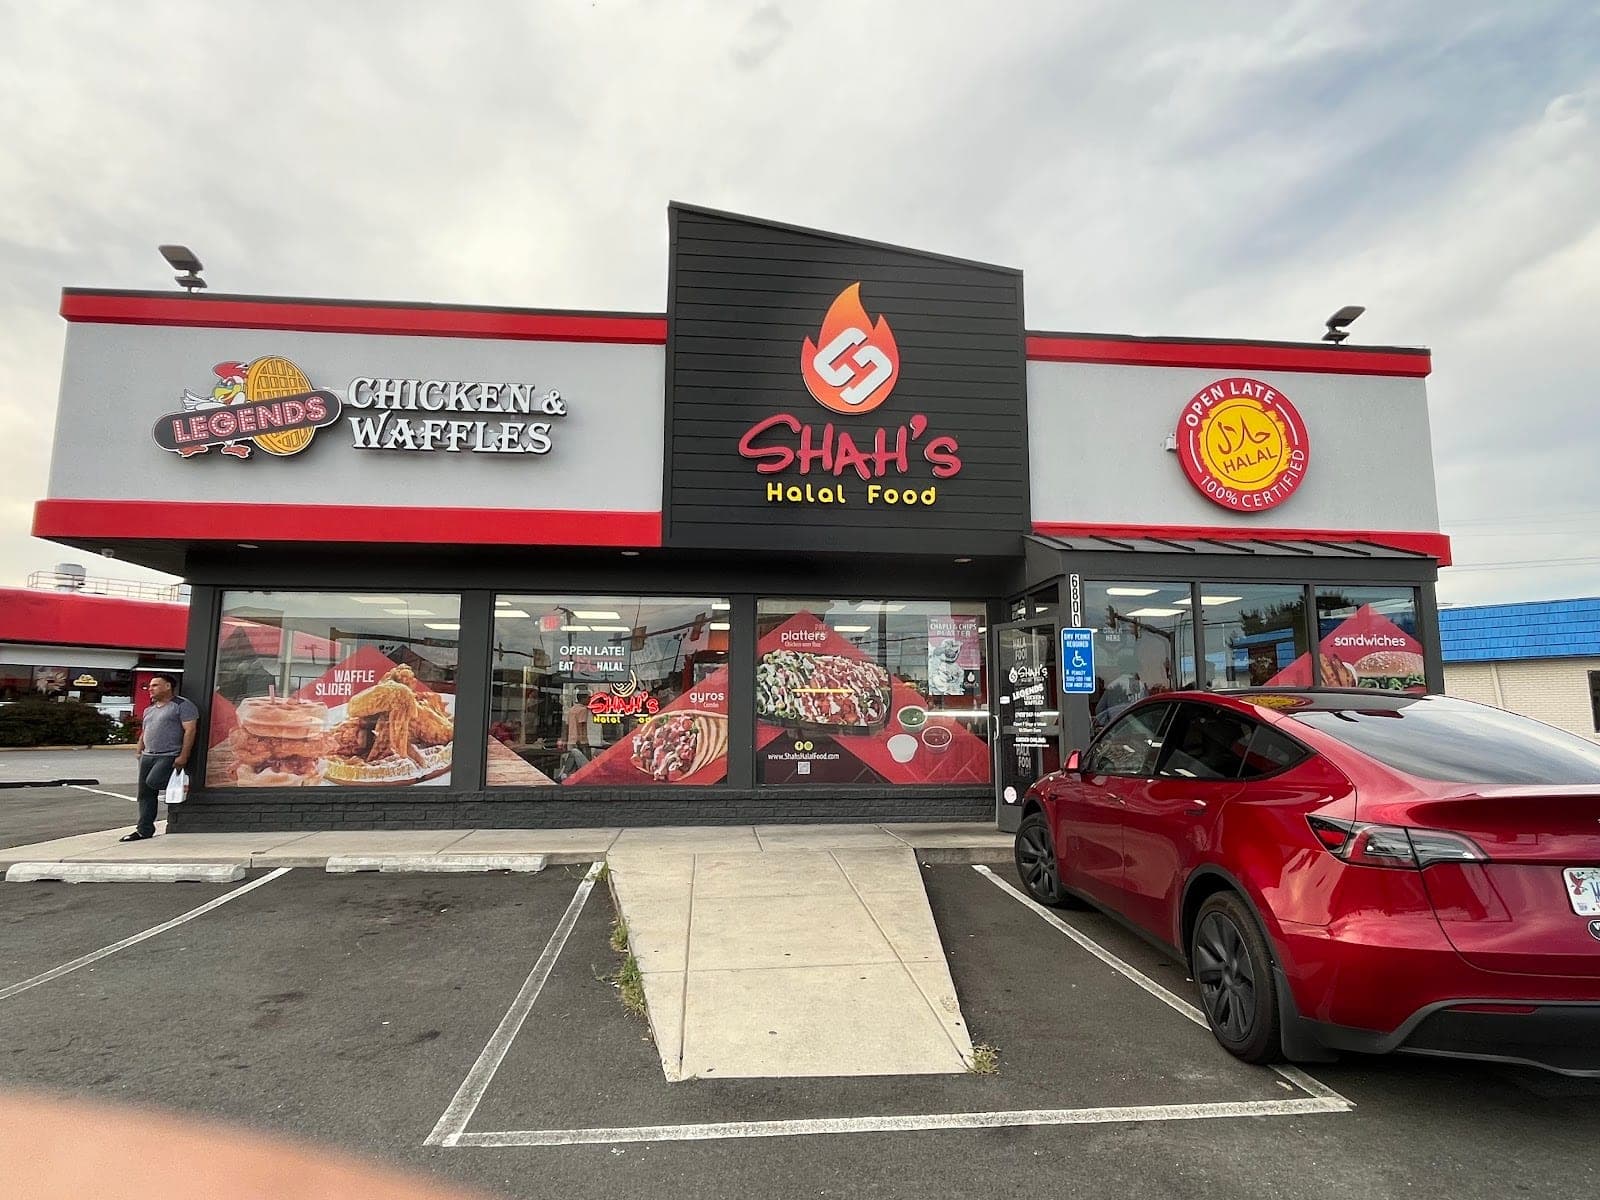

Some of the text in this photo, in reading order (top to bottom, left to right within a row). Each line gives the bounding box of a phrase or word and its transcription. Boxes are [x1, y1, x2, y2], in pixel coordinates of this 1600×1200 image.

[347, 377, 567, 416] CHICKEN &
[1185, 381, 1276, 427] OPEN LATE
[172, 396, 327, 443] LEGENDS
[348, 411, 552, 455] WAFFLES
[1223, 447, 1278, 474] HALAL
[1201, 449, 1305, 508] 100% CERTIFIED
[766, 482, 936, 505] Halal Food
[781, 630, 826, 643] platters
[1334, 634, 1406, 648] sandwiches
[559, 645, 625, 656] OPEN LATE!
[558, 661, 624, 672] EAT HALAL
[334, 670, 375, 683] WAFFLE
[315, 683, 352, 696] SLIDER
[689, 691, 725, 703] gyros
[593, 715, 620, 723] Halal
